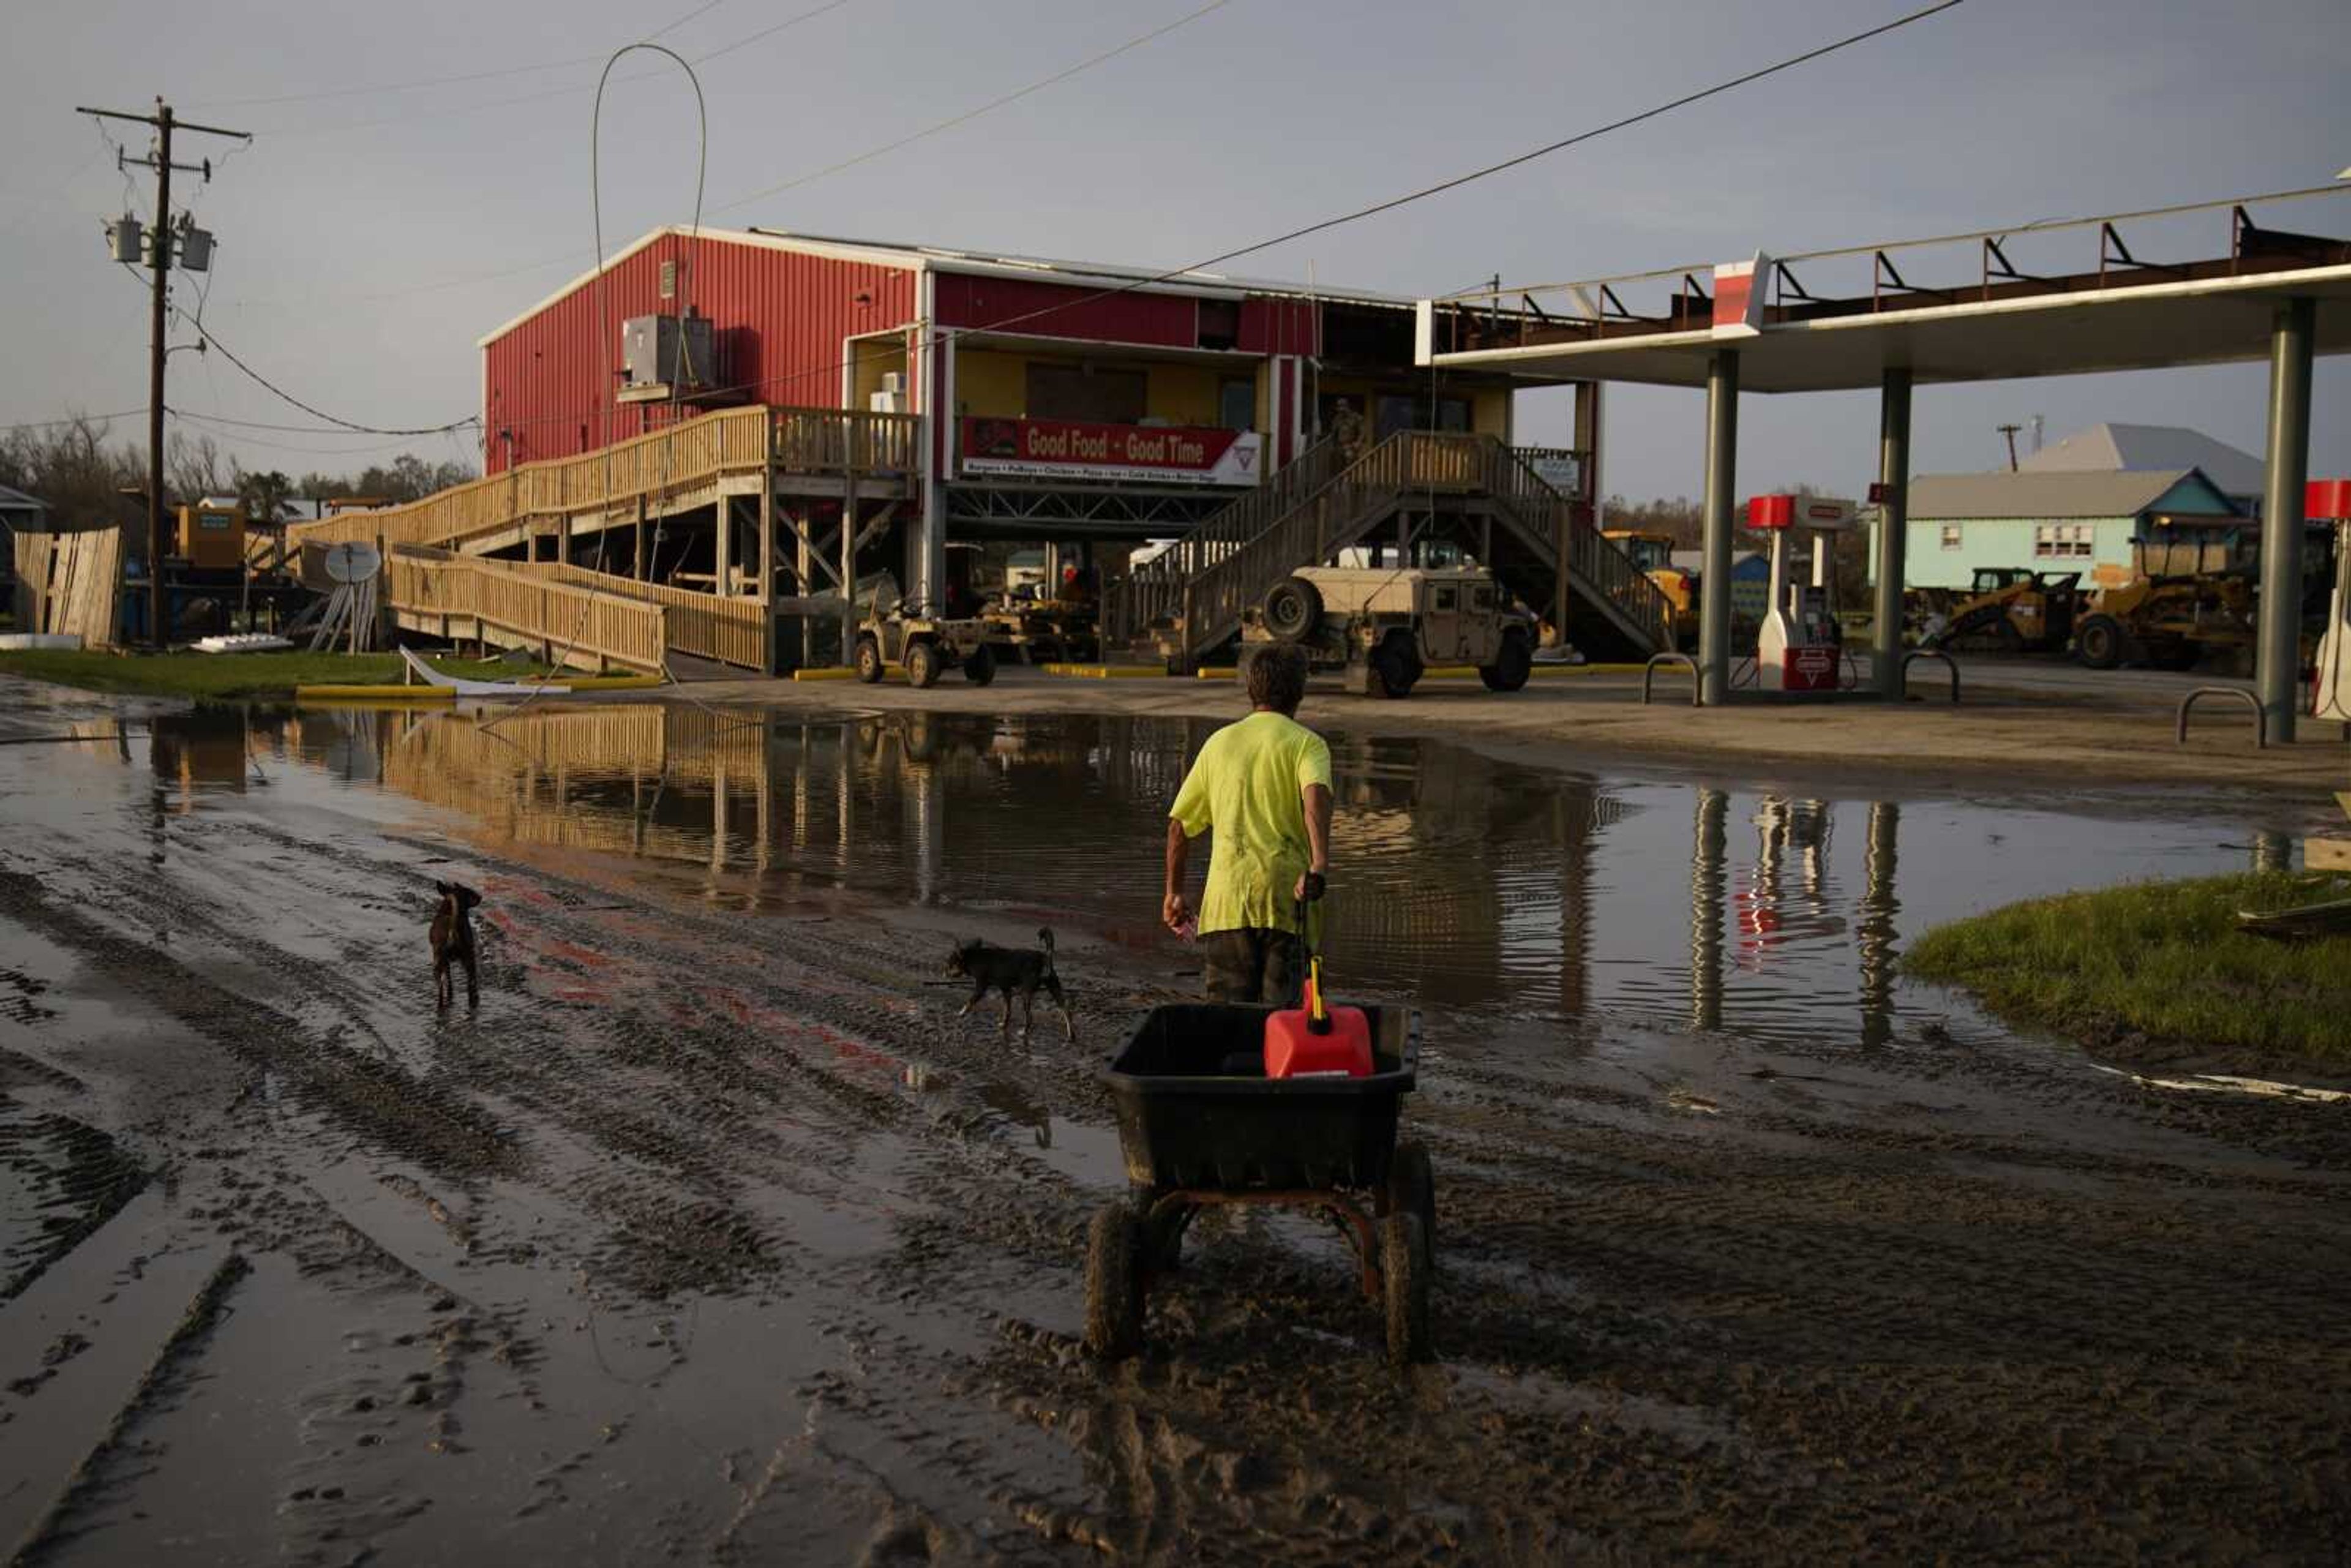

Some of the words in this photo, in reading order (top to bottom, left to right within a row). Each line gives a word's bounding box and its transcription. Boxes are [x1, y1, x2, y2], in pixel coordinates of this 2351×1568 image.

[1028, 427, 1067, 456] Good
[1071, 429, 1107, 459] Food
[1127, 432, 1165, 461] Good
[1169, 434, 1204, 464] Time
